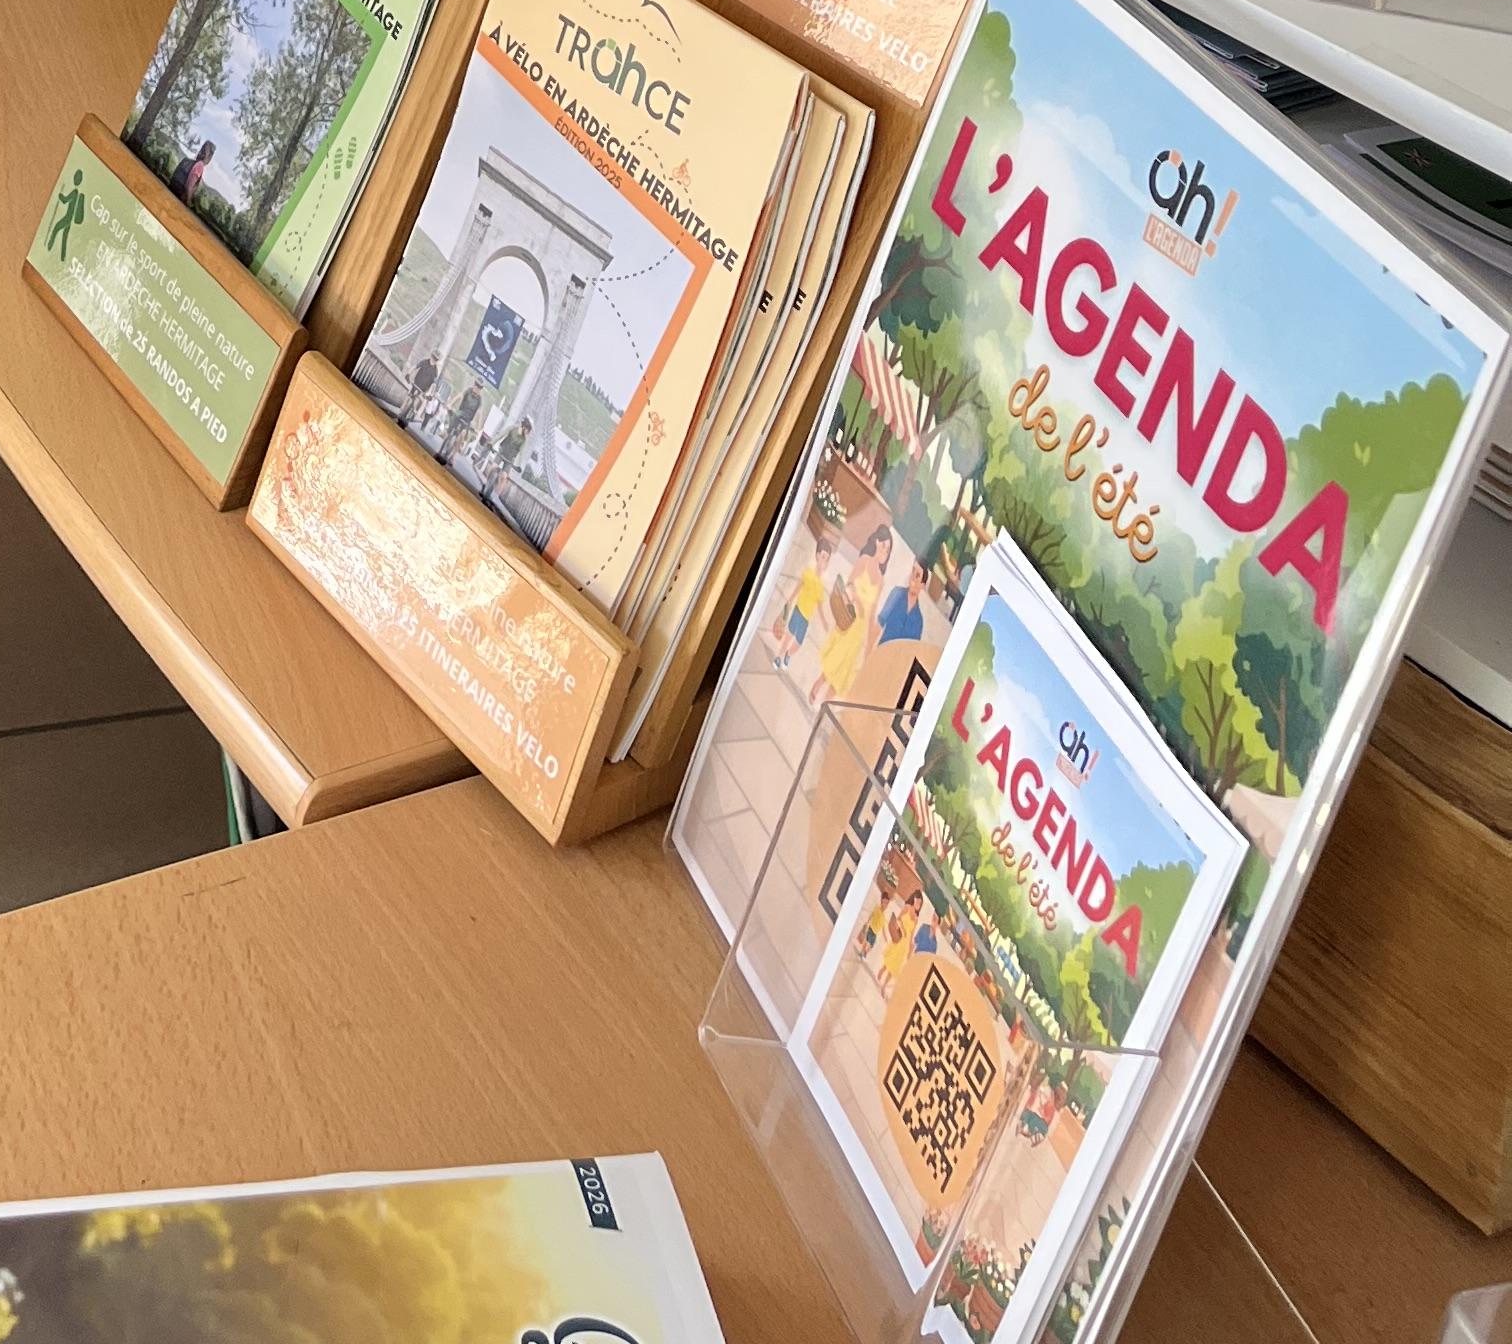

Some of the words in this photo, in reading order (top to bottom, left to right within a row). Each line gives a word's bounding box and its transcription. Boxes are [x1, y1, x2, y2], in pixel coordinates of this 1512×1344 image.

[878, 29, 929, 75] VELO
[488, 20, 503, 45] À
[505, 34, 543, 82] VÉLO
[543, 74, 568, 105] EN
[564, 98, 640, 177] ARDÈCHE
[639, 168, 738, 272] HERMITAGE
[554, 116, 596, 165] ÉDITION
[594, 157, 623, 190] 2025
[1149, 149, 1240, 258] ah!
[68, 257, 122, 327] SELECTION
[120, 318, 134, 341] de
[133, 330, 147, 353] 25
[146, 346, 192, 405] RANDOS
[190, 396, 199, 417] A
[200, 408, 228, 445] PIED
[90, 194, 110, 226] Cap
[109, 217, 128, 243] sur
[126, 234, 138, 255] le
[137, 247, 167, 287] sport
[166, 278, 181, 300] de
[180, 294, 217, 340] pleine
[216, 333, 255, 381] nature
[96, 240, 113, 267] EN
[111, 258, 162, 322] ARDECHE
[159, 312, 226, 392] HERMITAGE
[931, 116, 1350, 638] L'AGENDA
[1007, 363, 1061, 451] de
[398, 611, 419, 637] 25
[419, 628, 514, 735] ITINERAIRES
[516, 721, 559, 780] VELO
[951, 676, 1143, 978] L'AGENDA
[991, 821, 1017, 868] de
[579, 1167, 609, 1215] 2026
